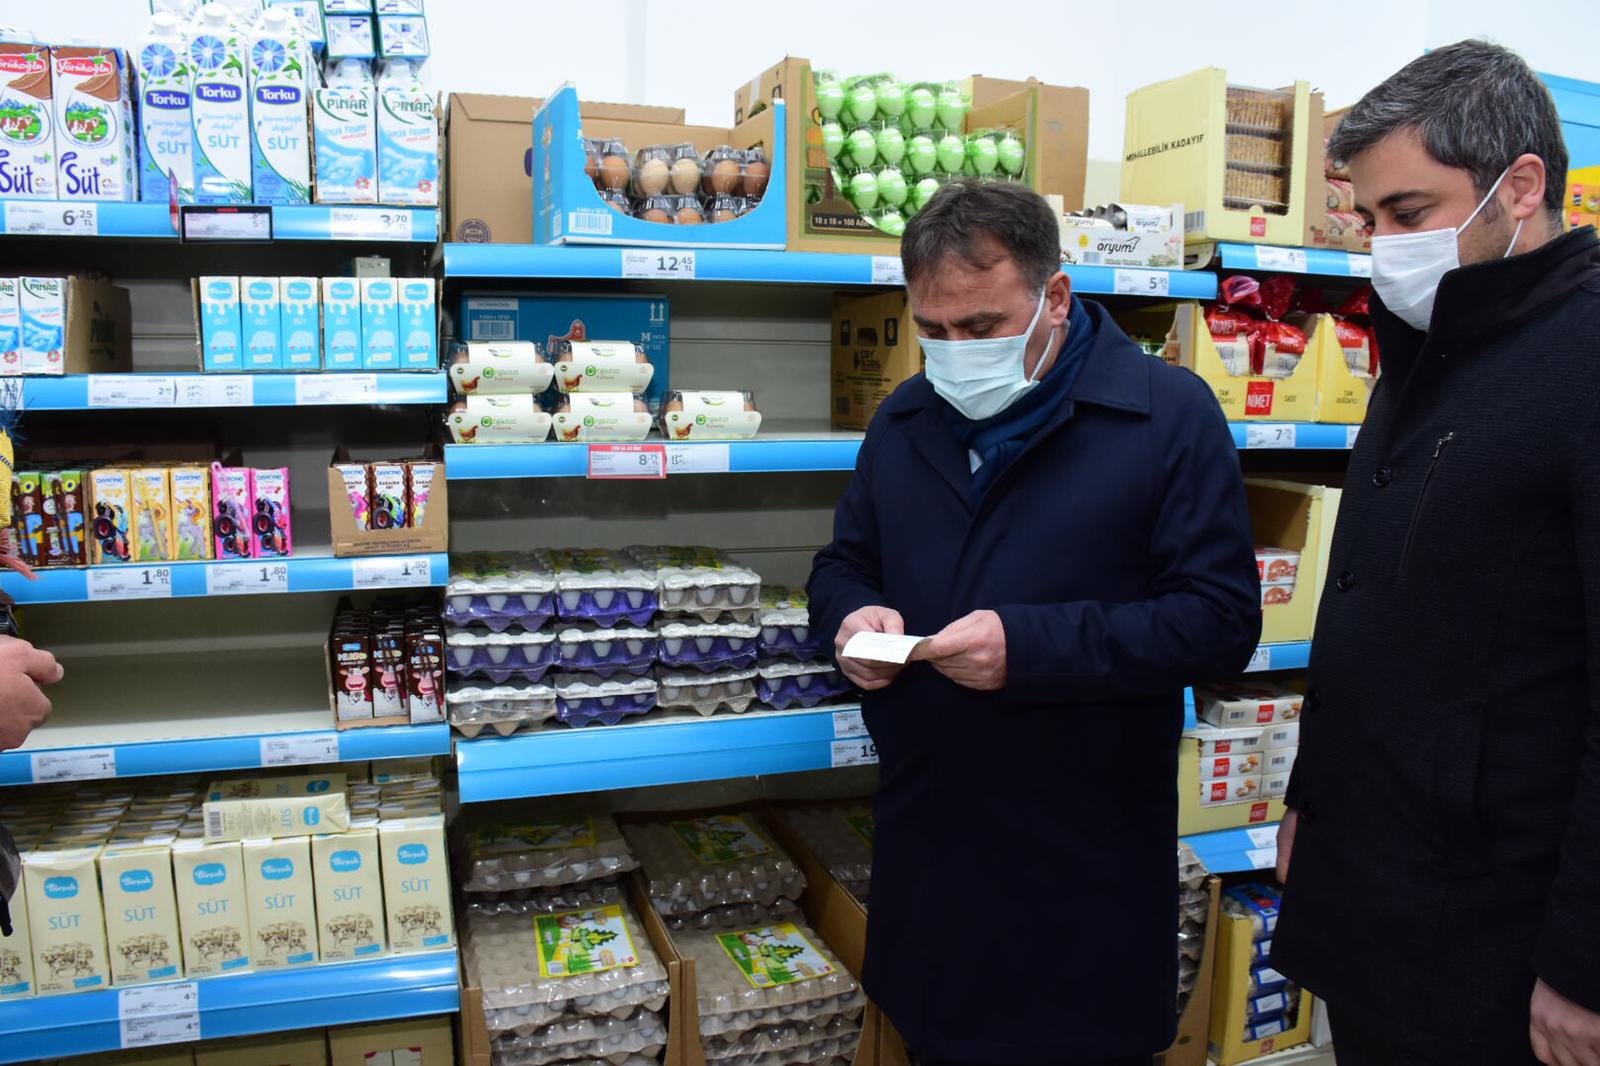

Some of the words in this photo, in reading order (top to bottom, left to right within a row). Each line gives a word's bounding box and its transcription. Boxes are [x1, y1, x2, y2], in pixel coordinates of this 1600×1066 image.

[150, 93, 186, 105] Torku
[200, 86, 236, 99] Torku
[261, 88, 296, 101] Torku
[1171, 134, 1204, 150] KADAYIF
[65, 163, 100, 196] Süt
[334, 884, 363, 902] SÜT
[402, 877, 431, 895] SÜT
[198, 897, 229, 916] SÜT
[265, 893, 297, 910] SÜT
[48, 912, 81, 930] SÜT
[124, 904, 156, 923] SÜT
